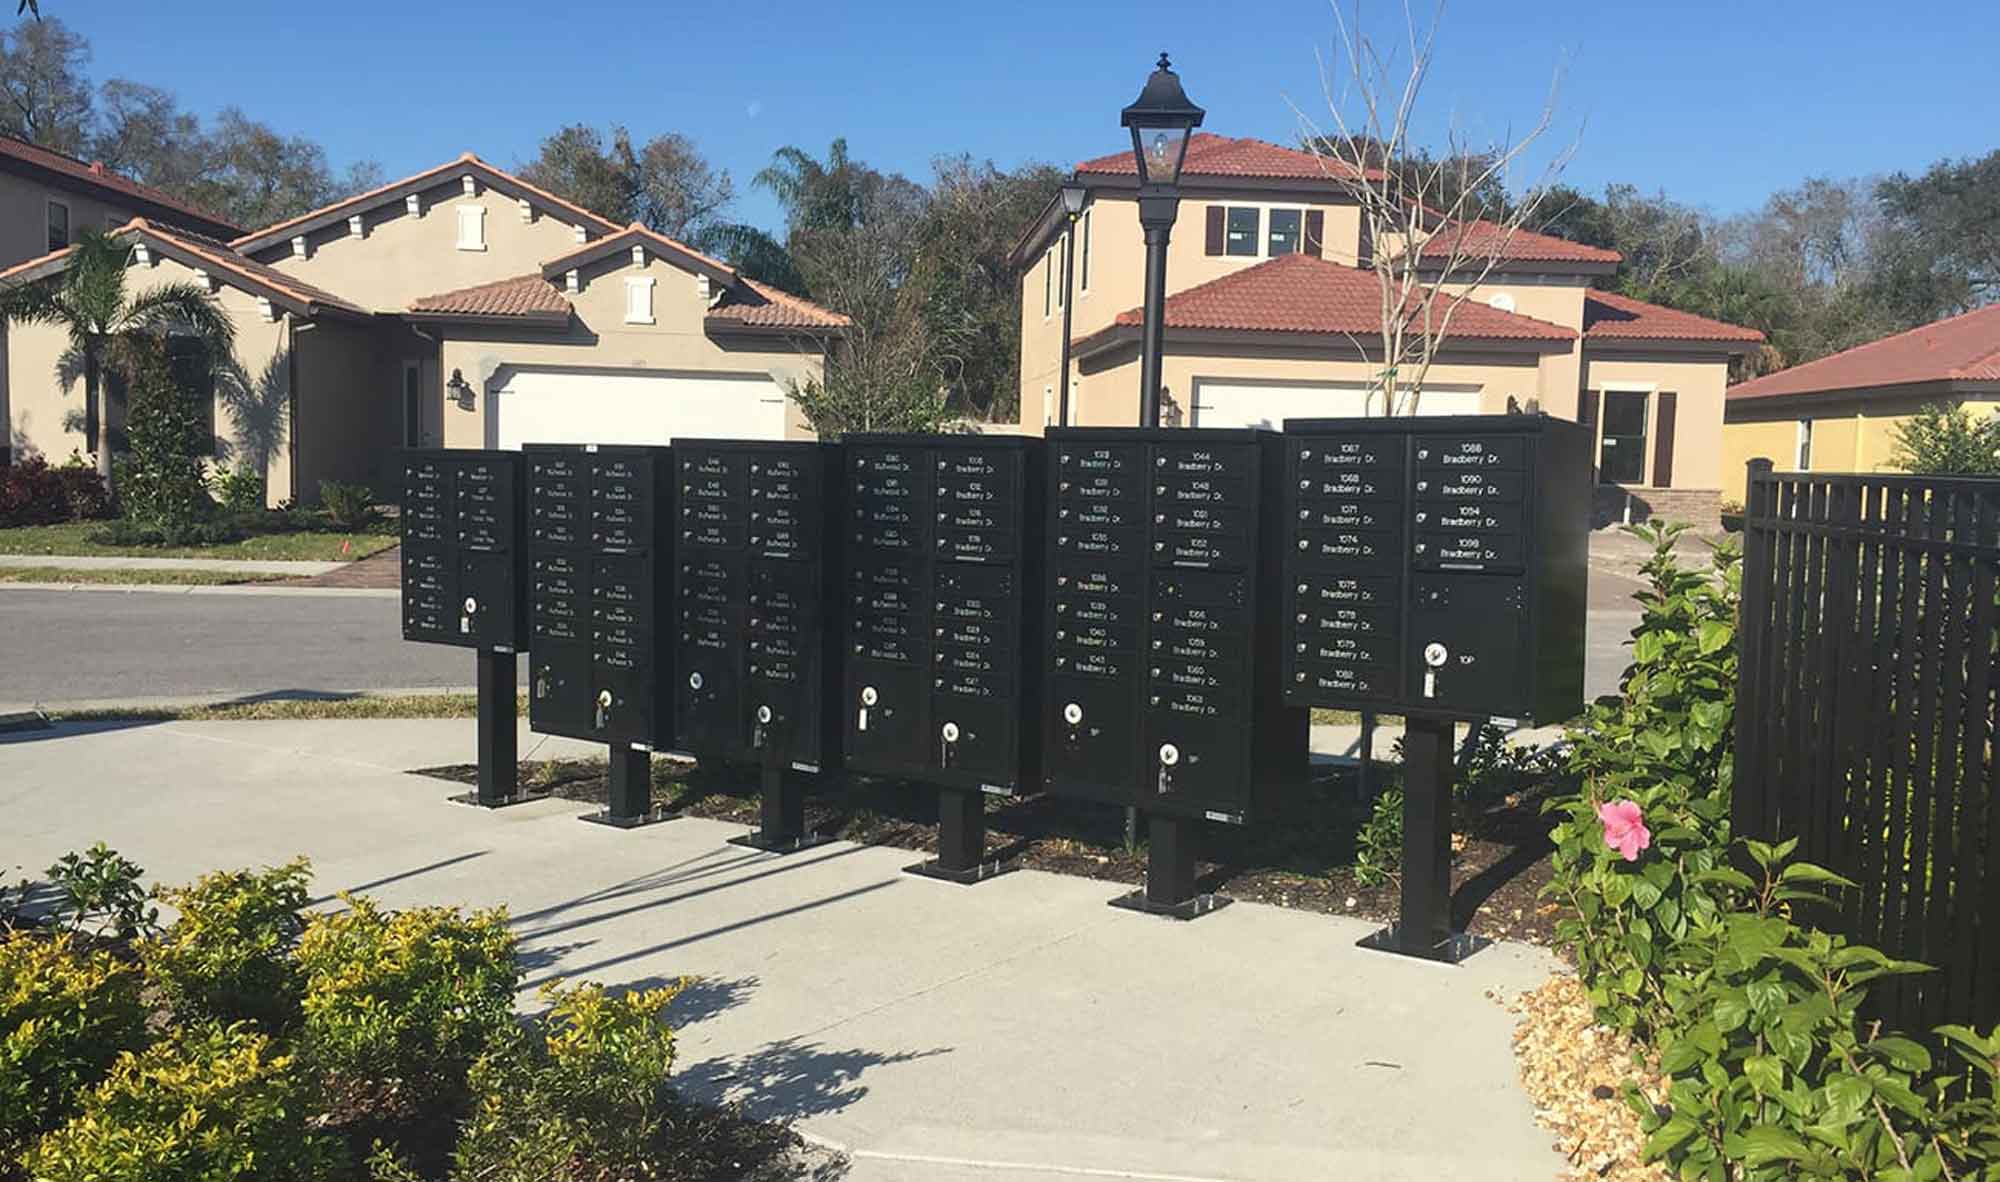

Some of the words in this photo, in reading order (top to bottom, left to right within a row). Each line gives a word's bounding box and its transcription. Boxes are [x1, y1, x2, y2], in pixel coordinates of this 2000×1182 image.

[1324, 455, 1362, 465] Bradberry
[1442, 455, 1485, 465] Bradberry
[1460, 475, 1483, 484] 1090
[1323, 484, 1361, 495] Bradberry
[1442, 485, 1484, 496] Bradberry
[1458, 507, 1481, 516] 1094
[1322, 515, 1361, 526] Bradberry
[1440, 517, 1482, 529] Bradberry
[1321, 544, 1361, 555] Bradberry
[1440, 549, 1482, 560] Bradberry
[1321, 590, 1359, 601] Bradberry
[1320, 619, 1359, 631] Bradberry
[1319, 649, 1358, 661] Bradberry
[1318, 679, 1356, 691] Bradberry
